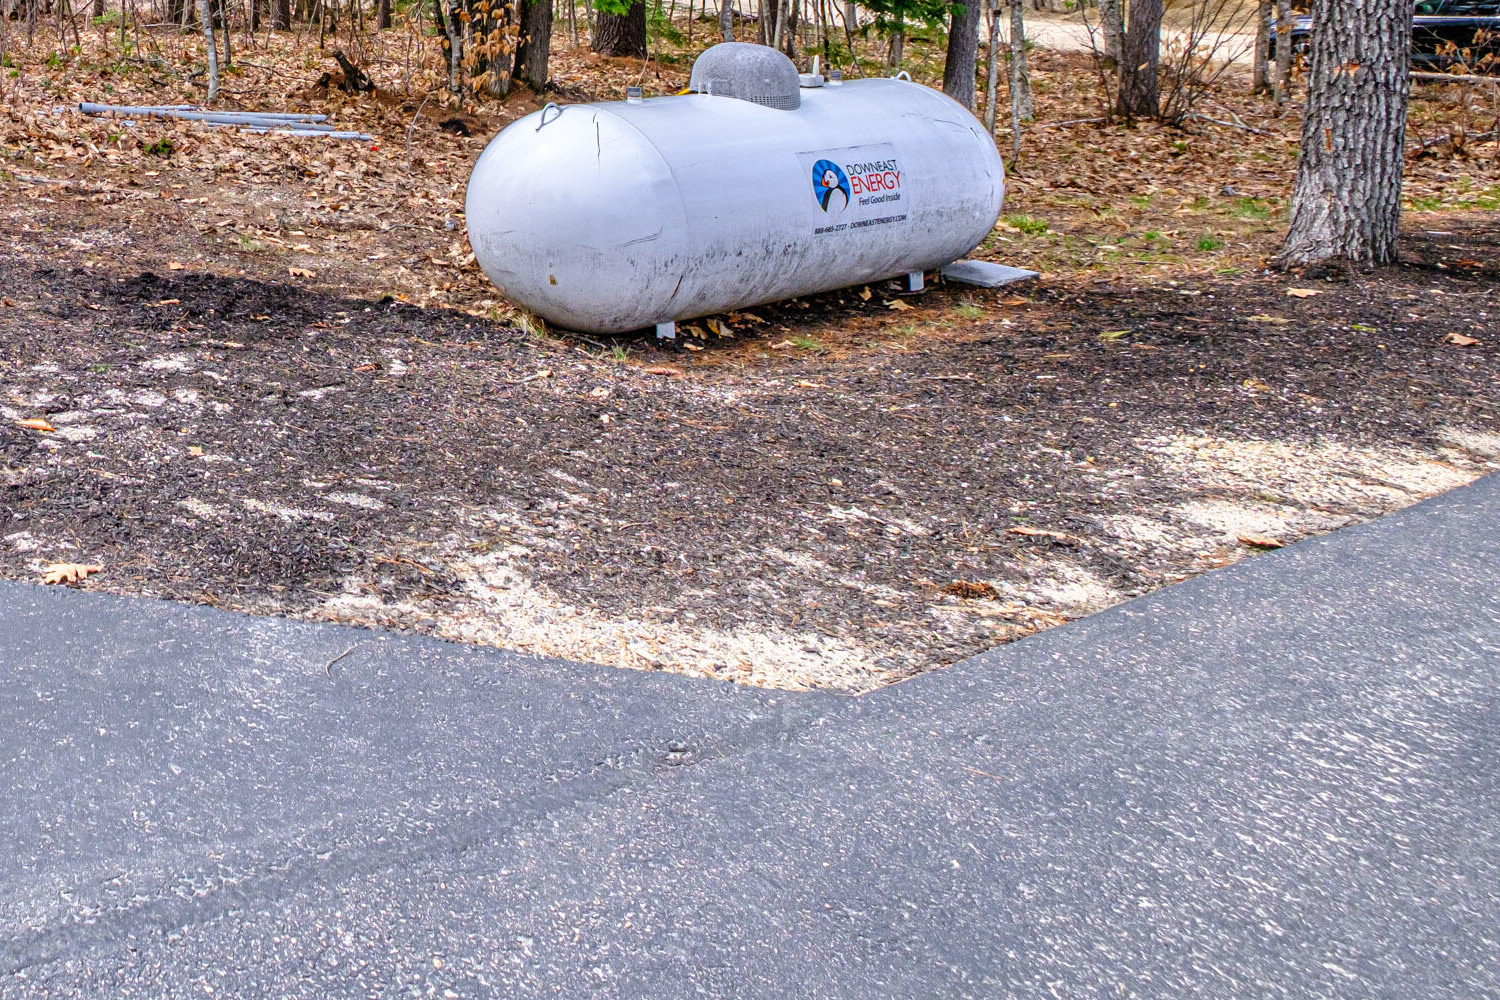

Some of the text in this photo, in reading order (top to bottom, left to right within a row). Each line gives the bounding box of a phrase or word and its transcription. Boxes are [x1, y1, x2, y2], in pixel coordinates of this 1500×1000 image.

[846, 160, 898, 176] DOWNEAST
[850, 171, 900, 195] ENERGY
[859, 196, 870, 206] Feel
[870, 194, 885, 204] Good
